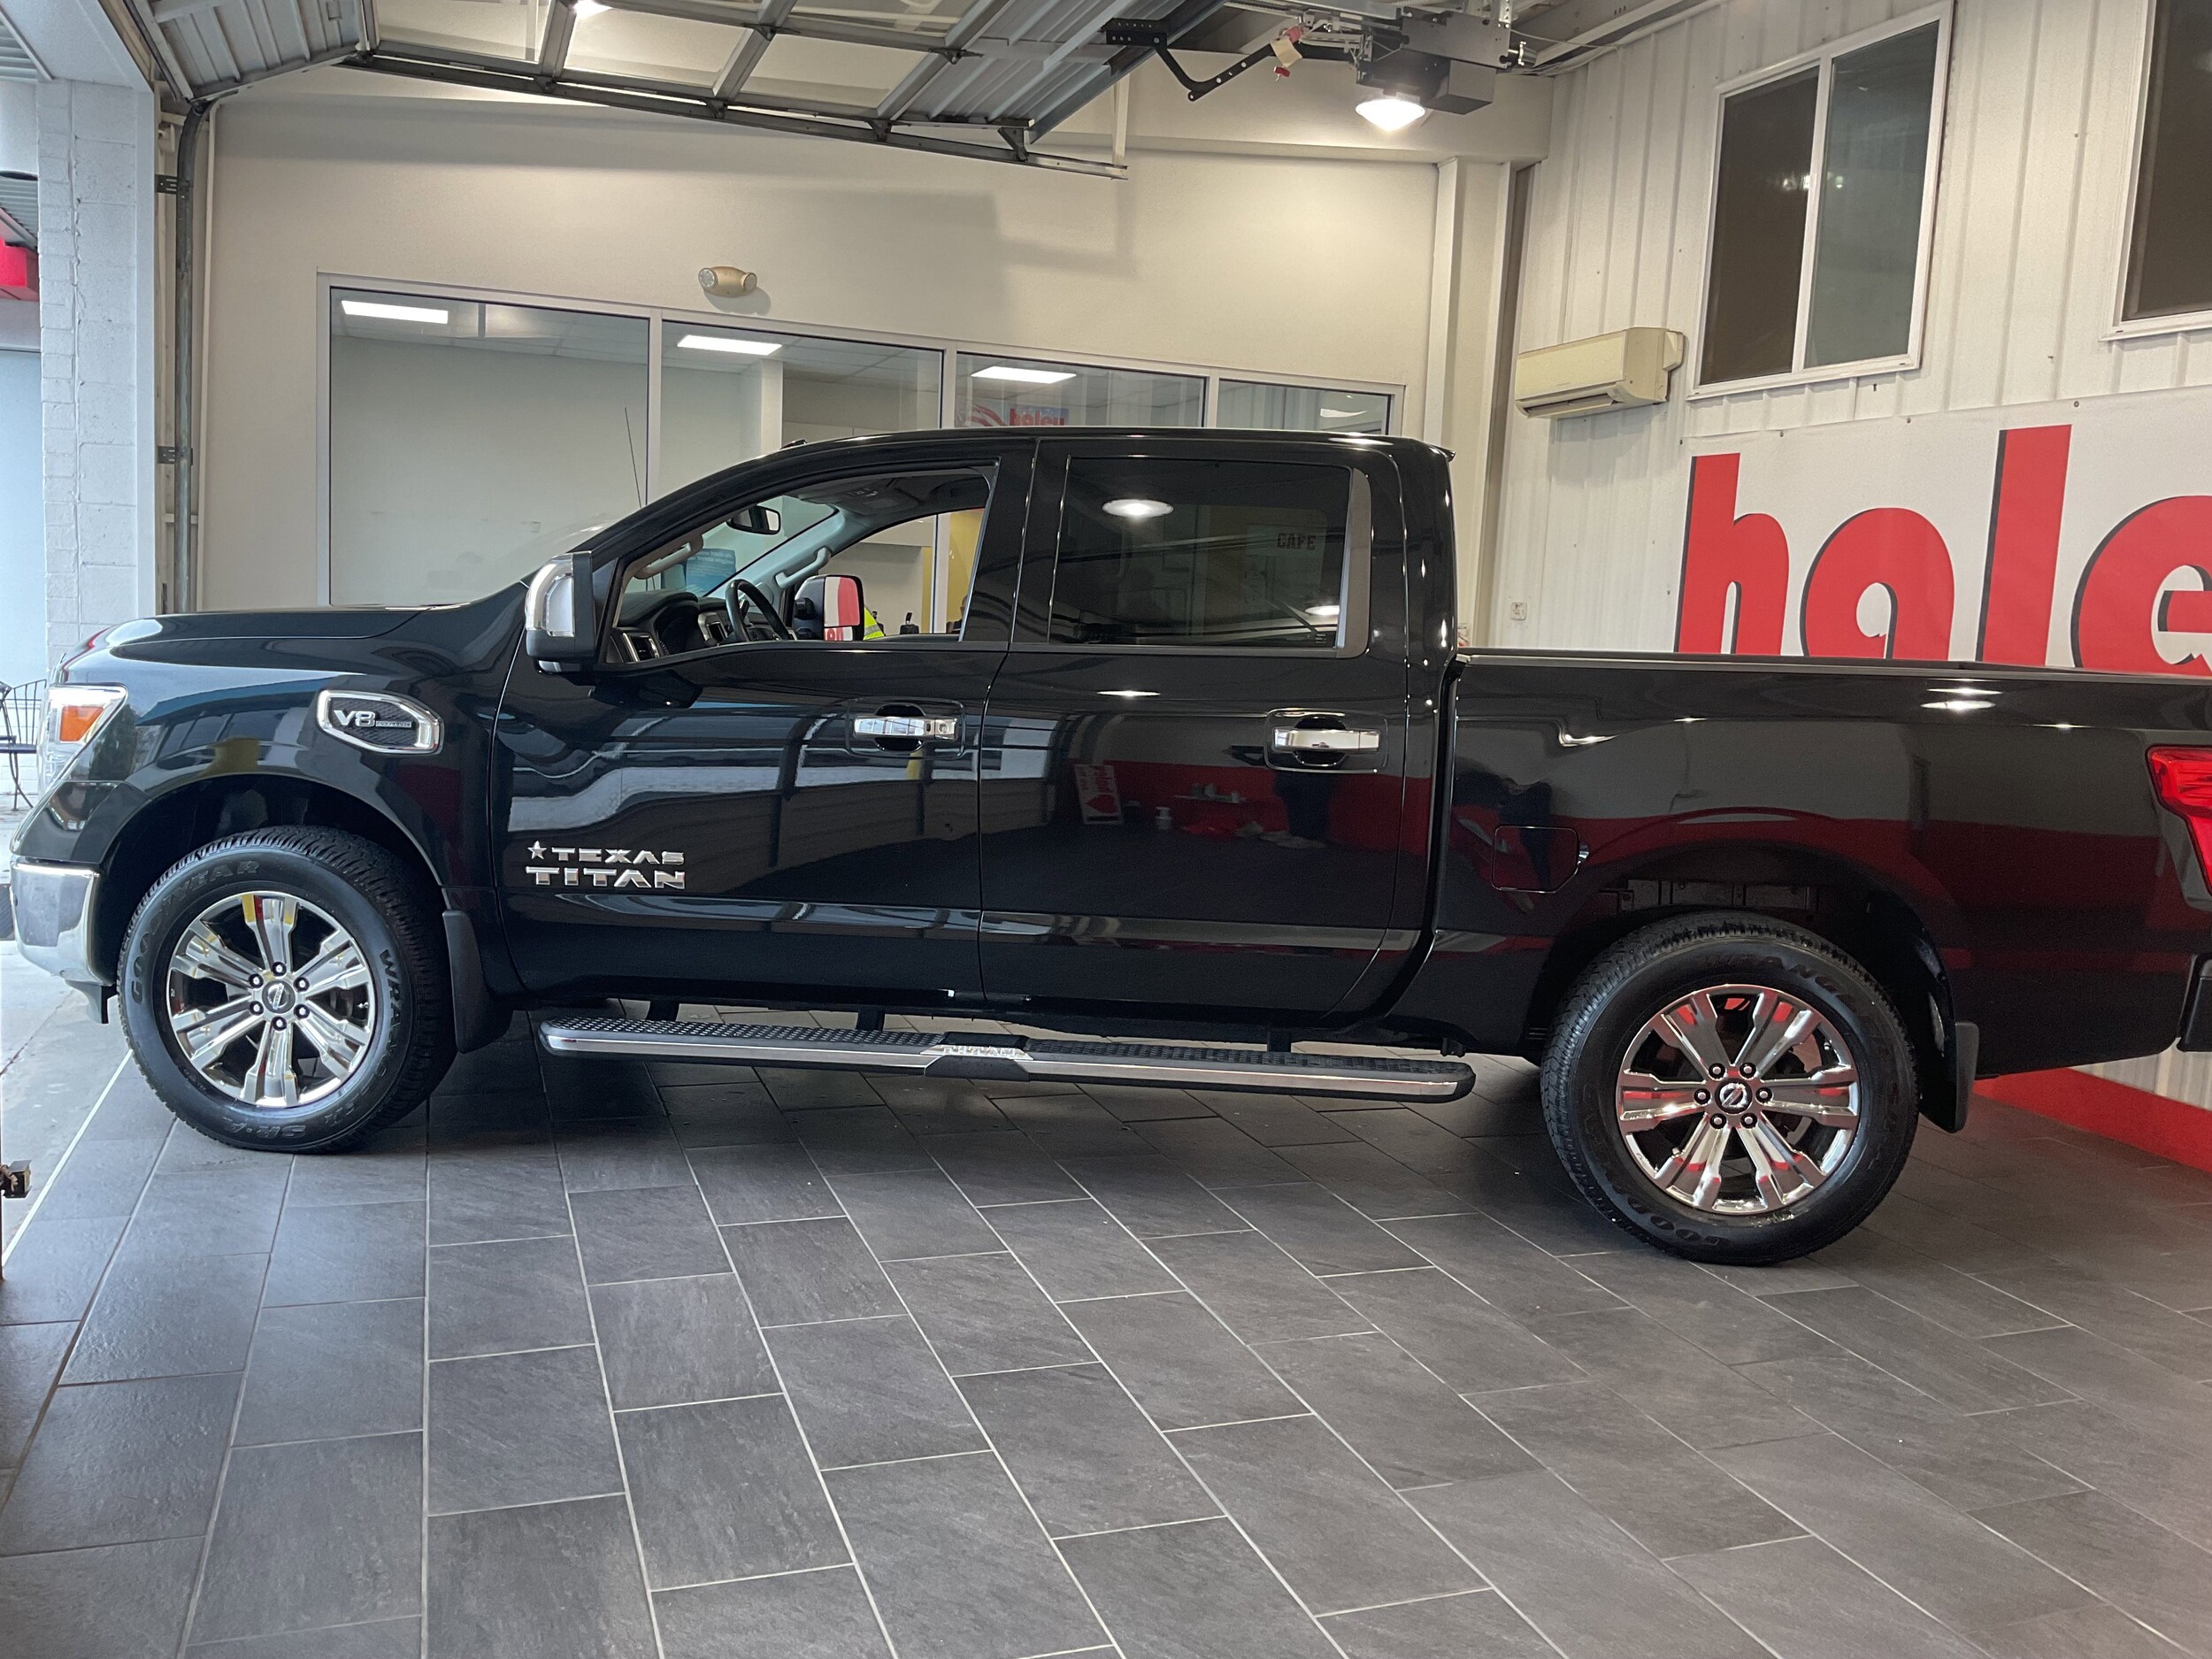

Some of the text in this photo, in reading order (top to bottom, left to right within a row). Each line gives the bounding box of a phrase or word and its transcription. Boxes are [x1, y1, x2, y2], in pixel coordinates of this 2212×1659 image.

[334, 710, 376, 727] V8
[551, 847, 685, 865] TEXAS
[525, 865, 686, 890] TITAN
